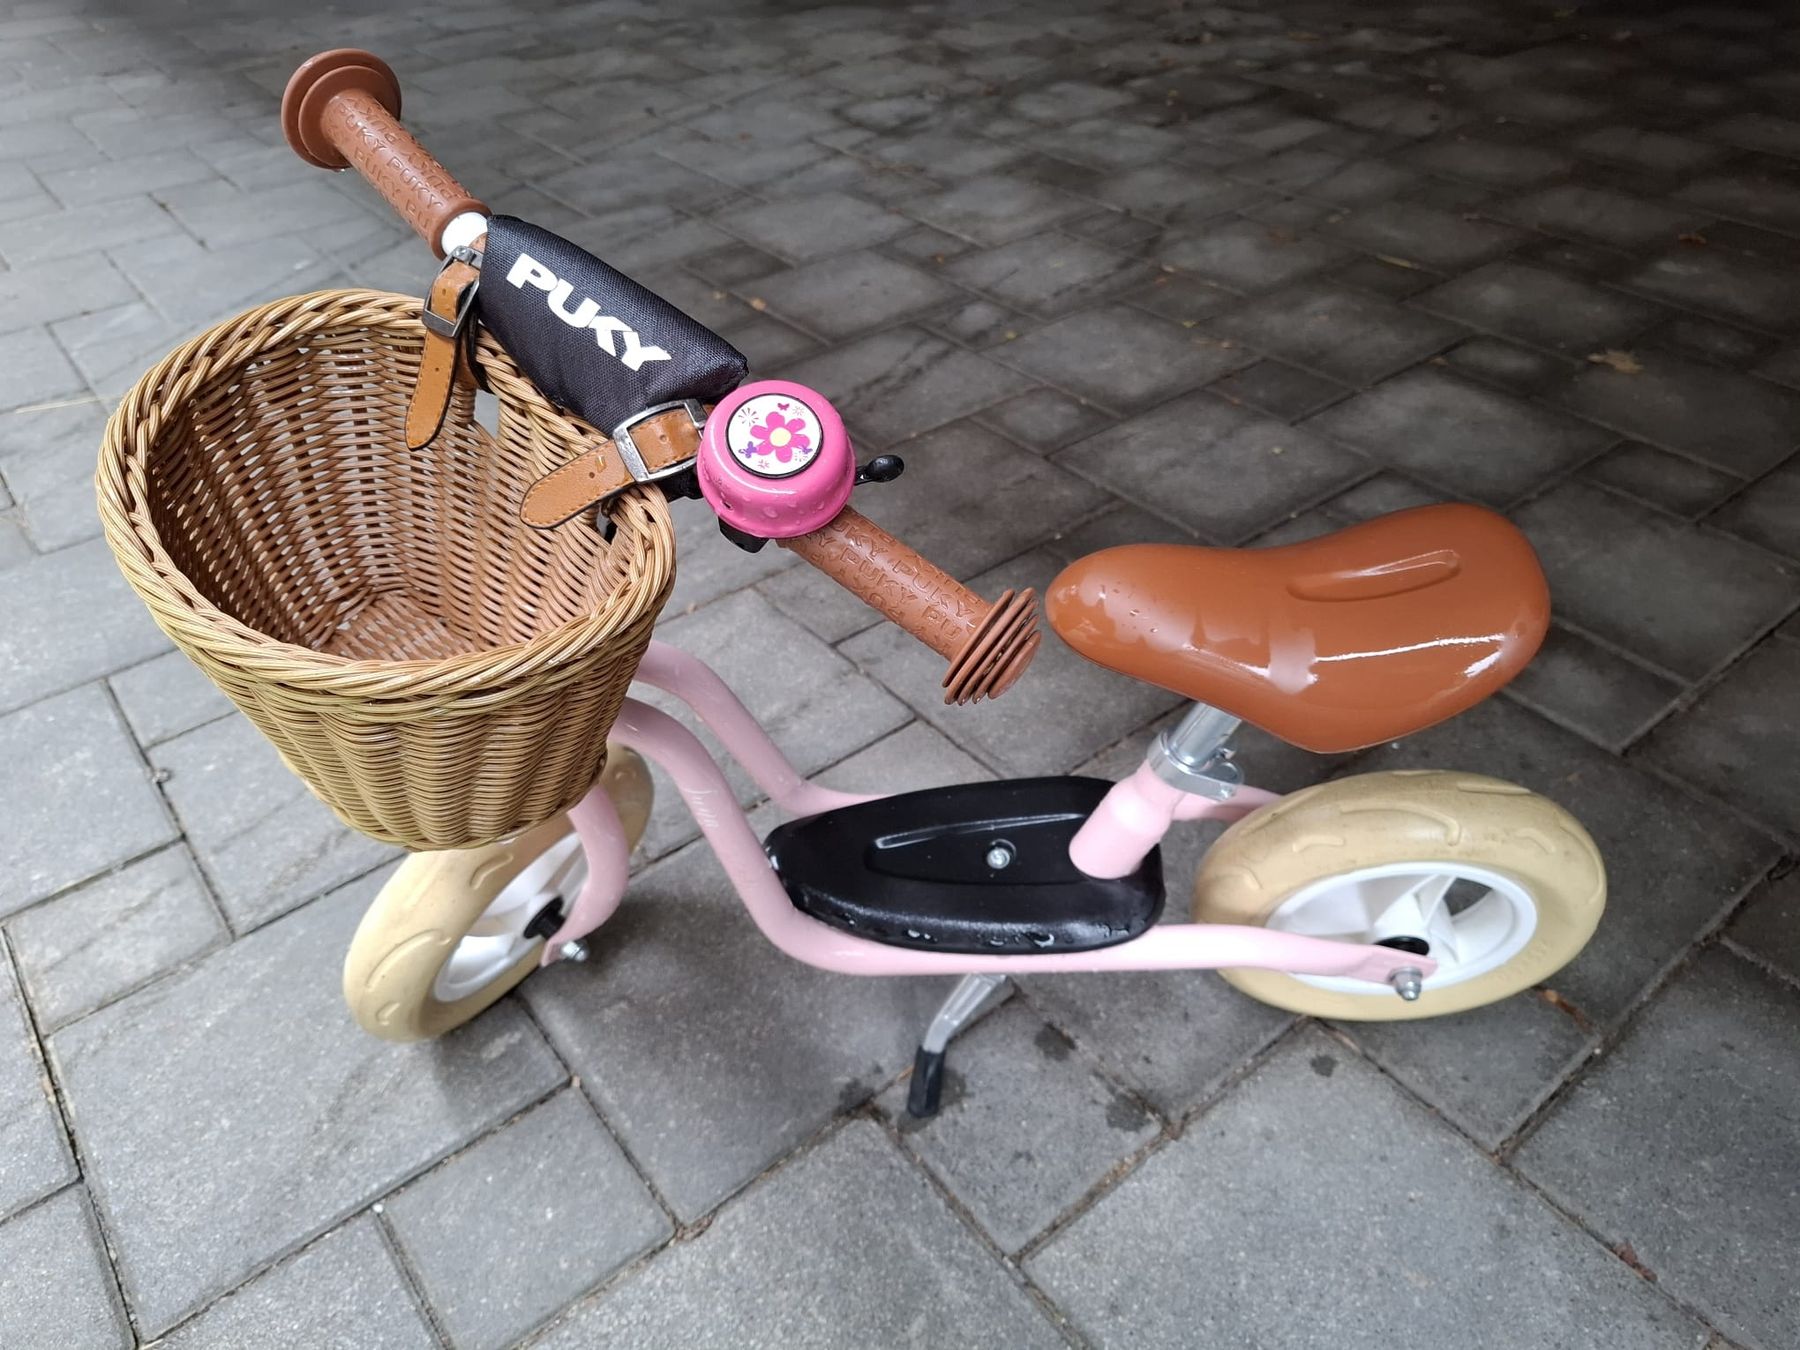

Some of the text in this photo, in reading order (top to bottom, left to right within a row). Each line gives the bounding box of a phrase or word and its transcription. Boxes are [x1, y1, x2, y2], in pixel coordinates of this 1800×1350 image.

[387, 157, 443, 209] PUKY
[506, 253, 672, 371] PUKY
[831, 518, 888, 561] UKY
[892, 559, 974, 620] PUKY
[840, 548, 917, 606] PUKY
